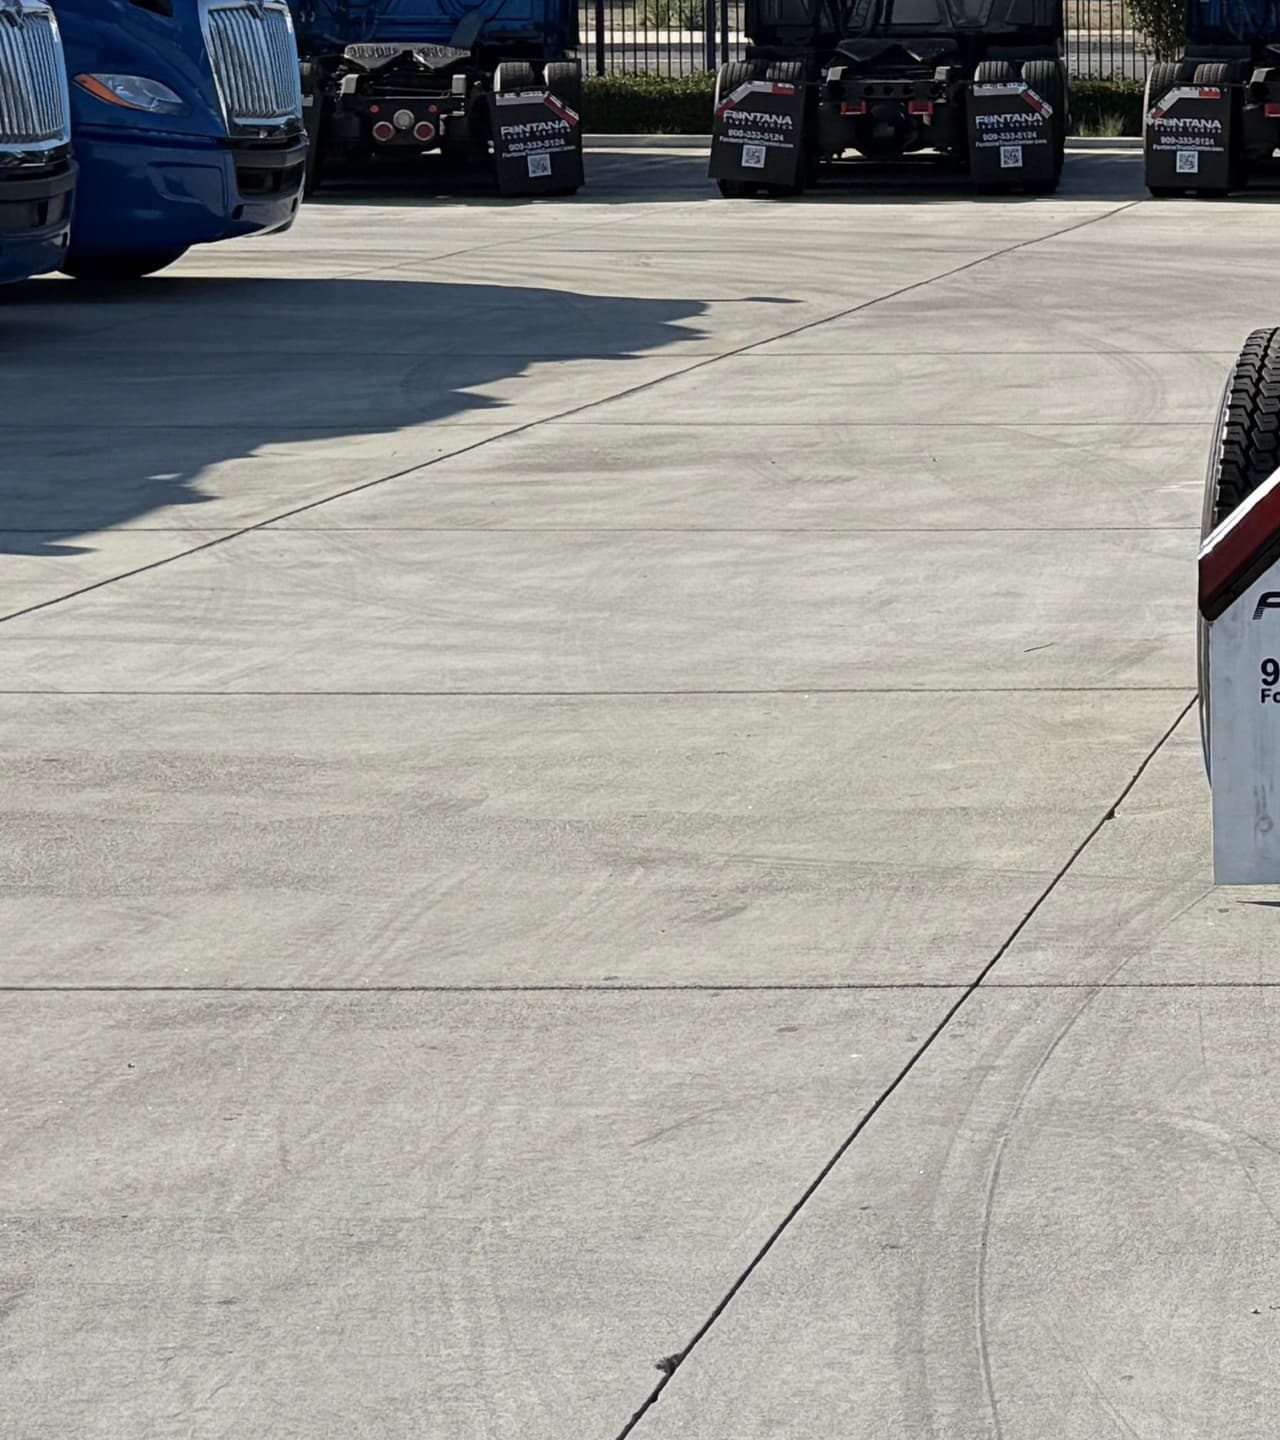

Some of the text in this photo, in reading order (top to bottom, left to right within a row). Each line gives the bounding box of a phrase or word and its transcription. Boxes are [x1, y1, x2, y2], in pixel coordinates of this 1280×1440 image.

[723, 110, 792, 125] FONTANA
[976, 113, 1043, 125] FONTANA
[1155, 118, 1222, 129] FONTANA
[501, 120, 570, 135] FONTANA
